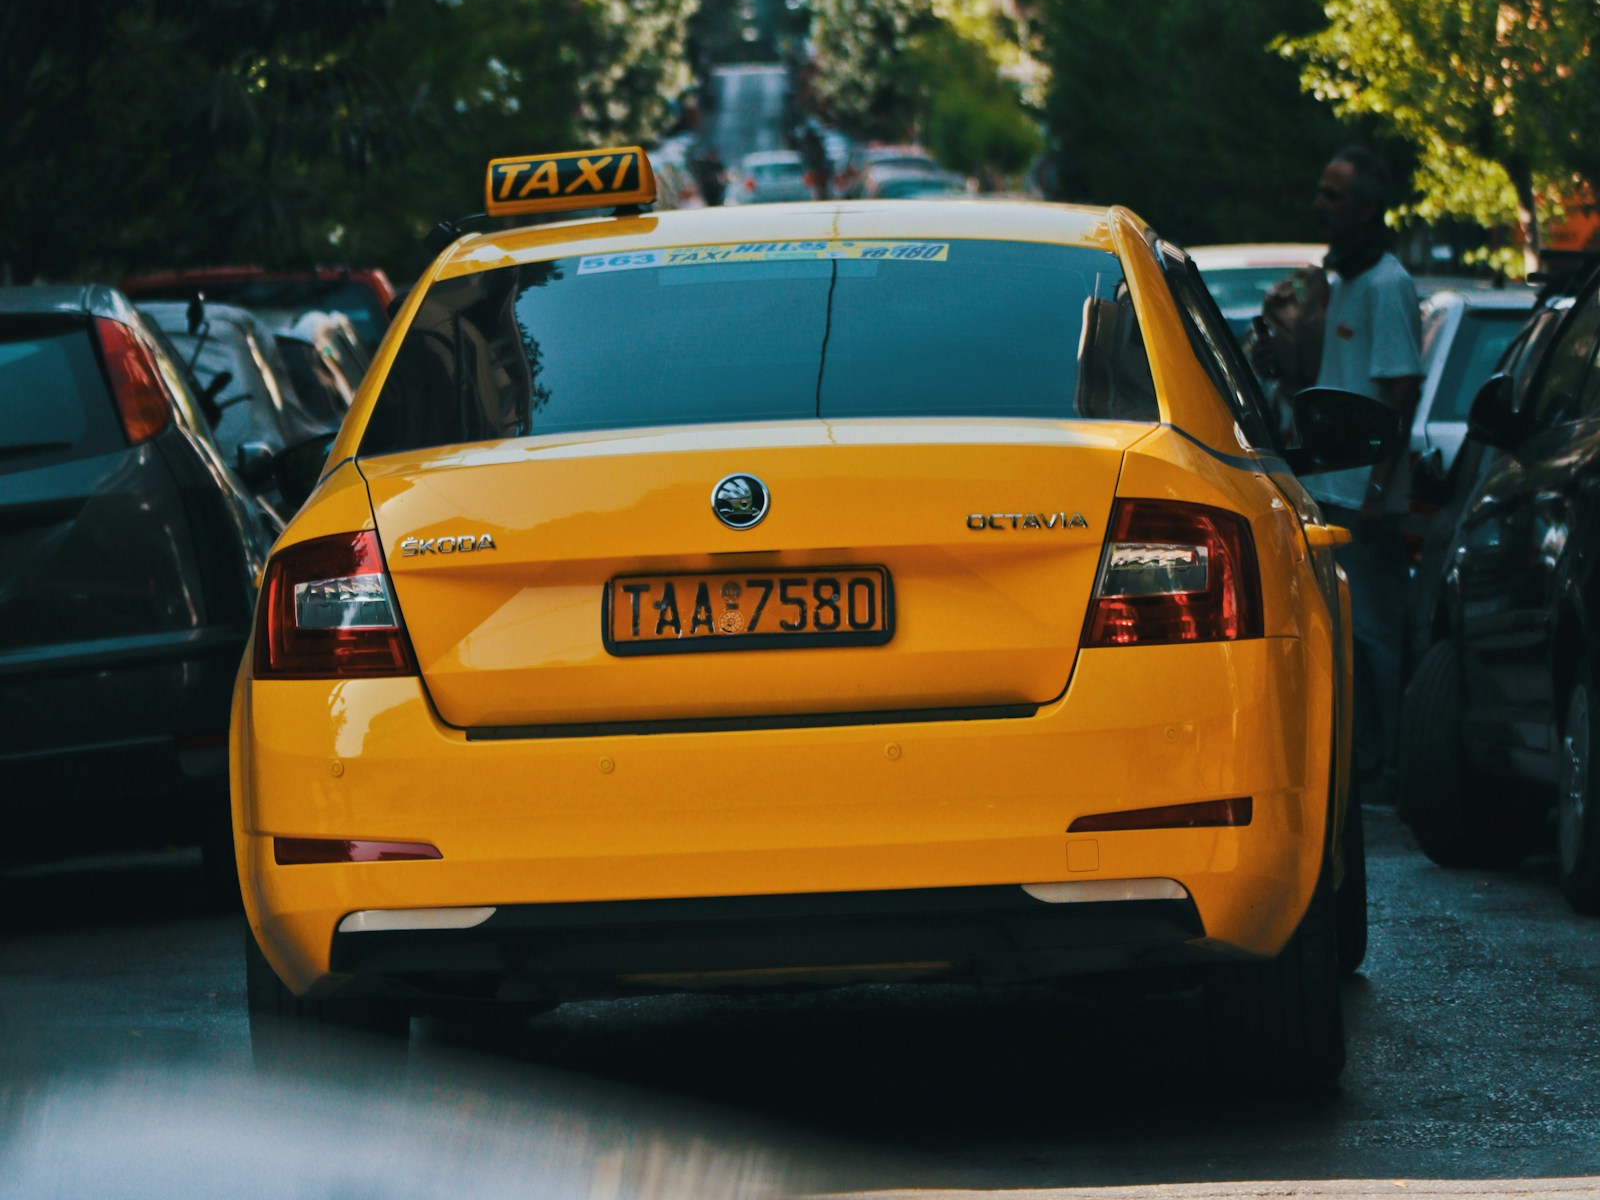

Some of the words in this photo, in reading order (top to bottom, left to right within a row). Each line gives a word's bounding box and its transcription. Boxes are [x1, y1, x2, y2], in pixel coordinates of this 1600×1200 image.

[497, 154, 633, 198] TAXI
[582, 253, 656, 269] 563
[668, 250, 732, 262] TAXI
[966, 511, 1088, 530] OCTAVIA
[401, 534, 496, 557] ŠKODA
[621, 581, 715, 637] TAA
[745, 577, 876, 632] 7580
